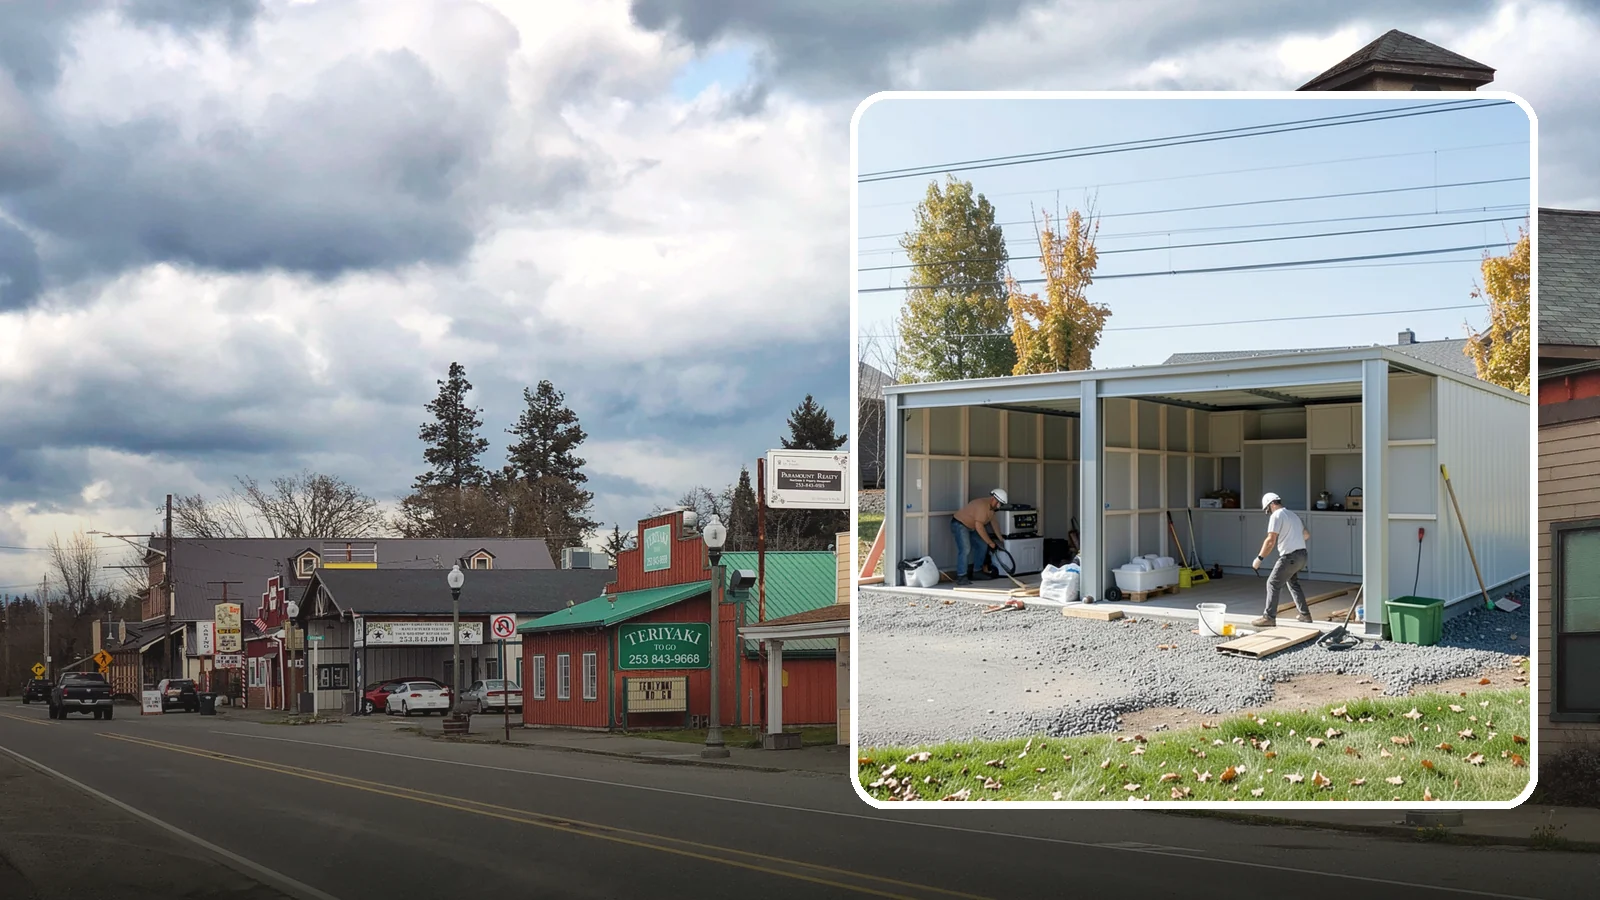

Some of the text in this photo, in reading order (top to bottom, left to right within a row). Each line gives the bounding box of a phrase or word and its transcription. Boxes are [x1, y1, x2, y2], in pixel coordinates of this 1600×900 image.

[625, 627, 702, 646] TERIYAKI
[629, 654, 700, 665] 253 843-9668
[639, 681, 672, 691] TERIYAKI
